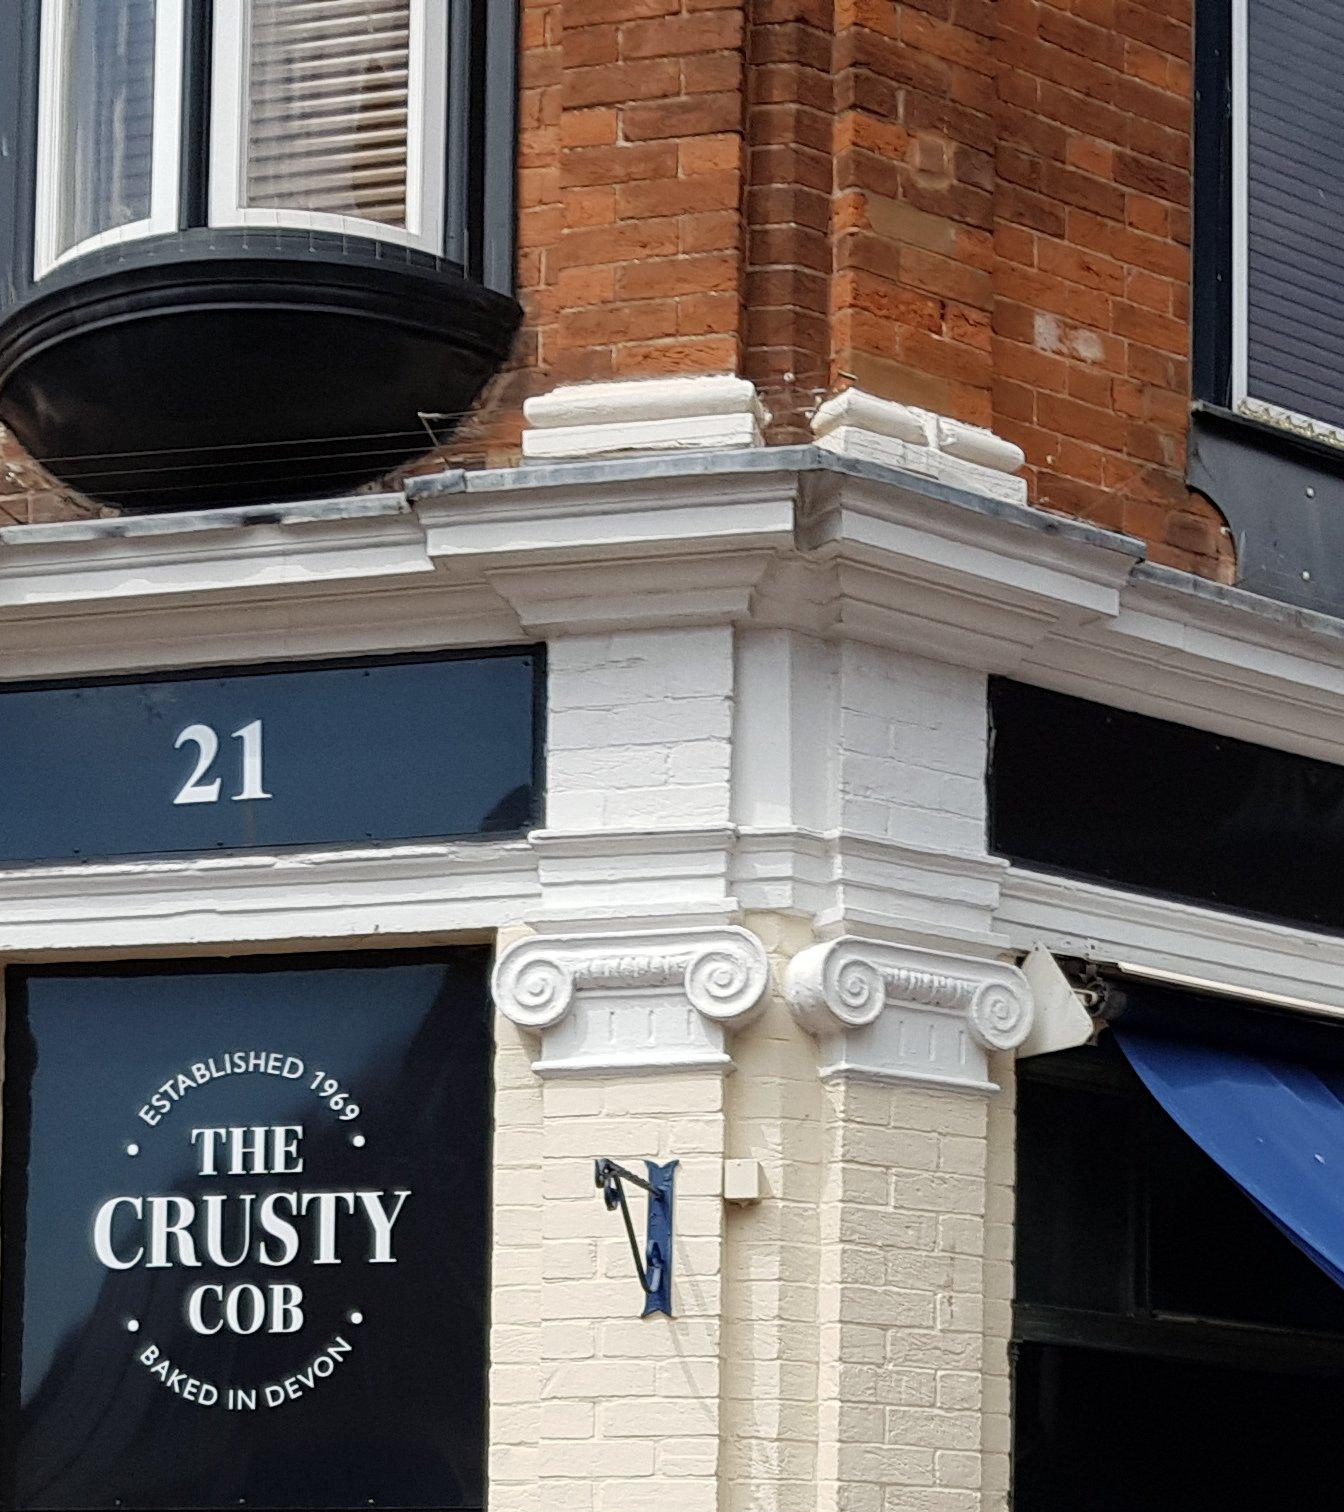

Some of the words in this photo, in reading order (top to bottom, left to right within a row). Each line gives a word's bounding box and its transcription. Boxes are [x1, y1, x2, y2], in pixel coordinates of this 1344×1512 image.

[173, 720, 273, 805] 21
[138, 1051, 305, 1127] ESTABLISHED
[309, 1070, 361, 1124] 1969
[191, 1124, 304, 1177] THE
[94, 1191, 412, 1270] CRUSTY
[188, 1284, 304, 1336] COB
[139, 1344, 218, 1408] BAKED
[228, 1388, 257, 1411] IN
[264, 1335, 353, 1410] DEVON
